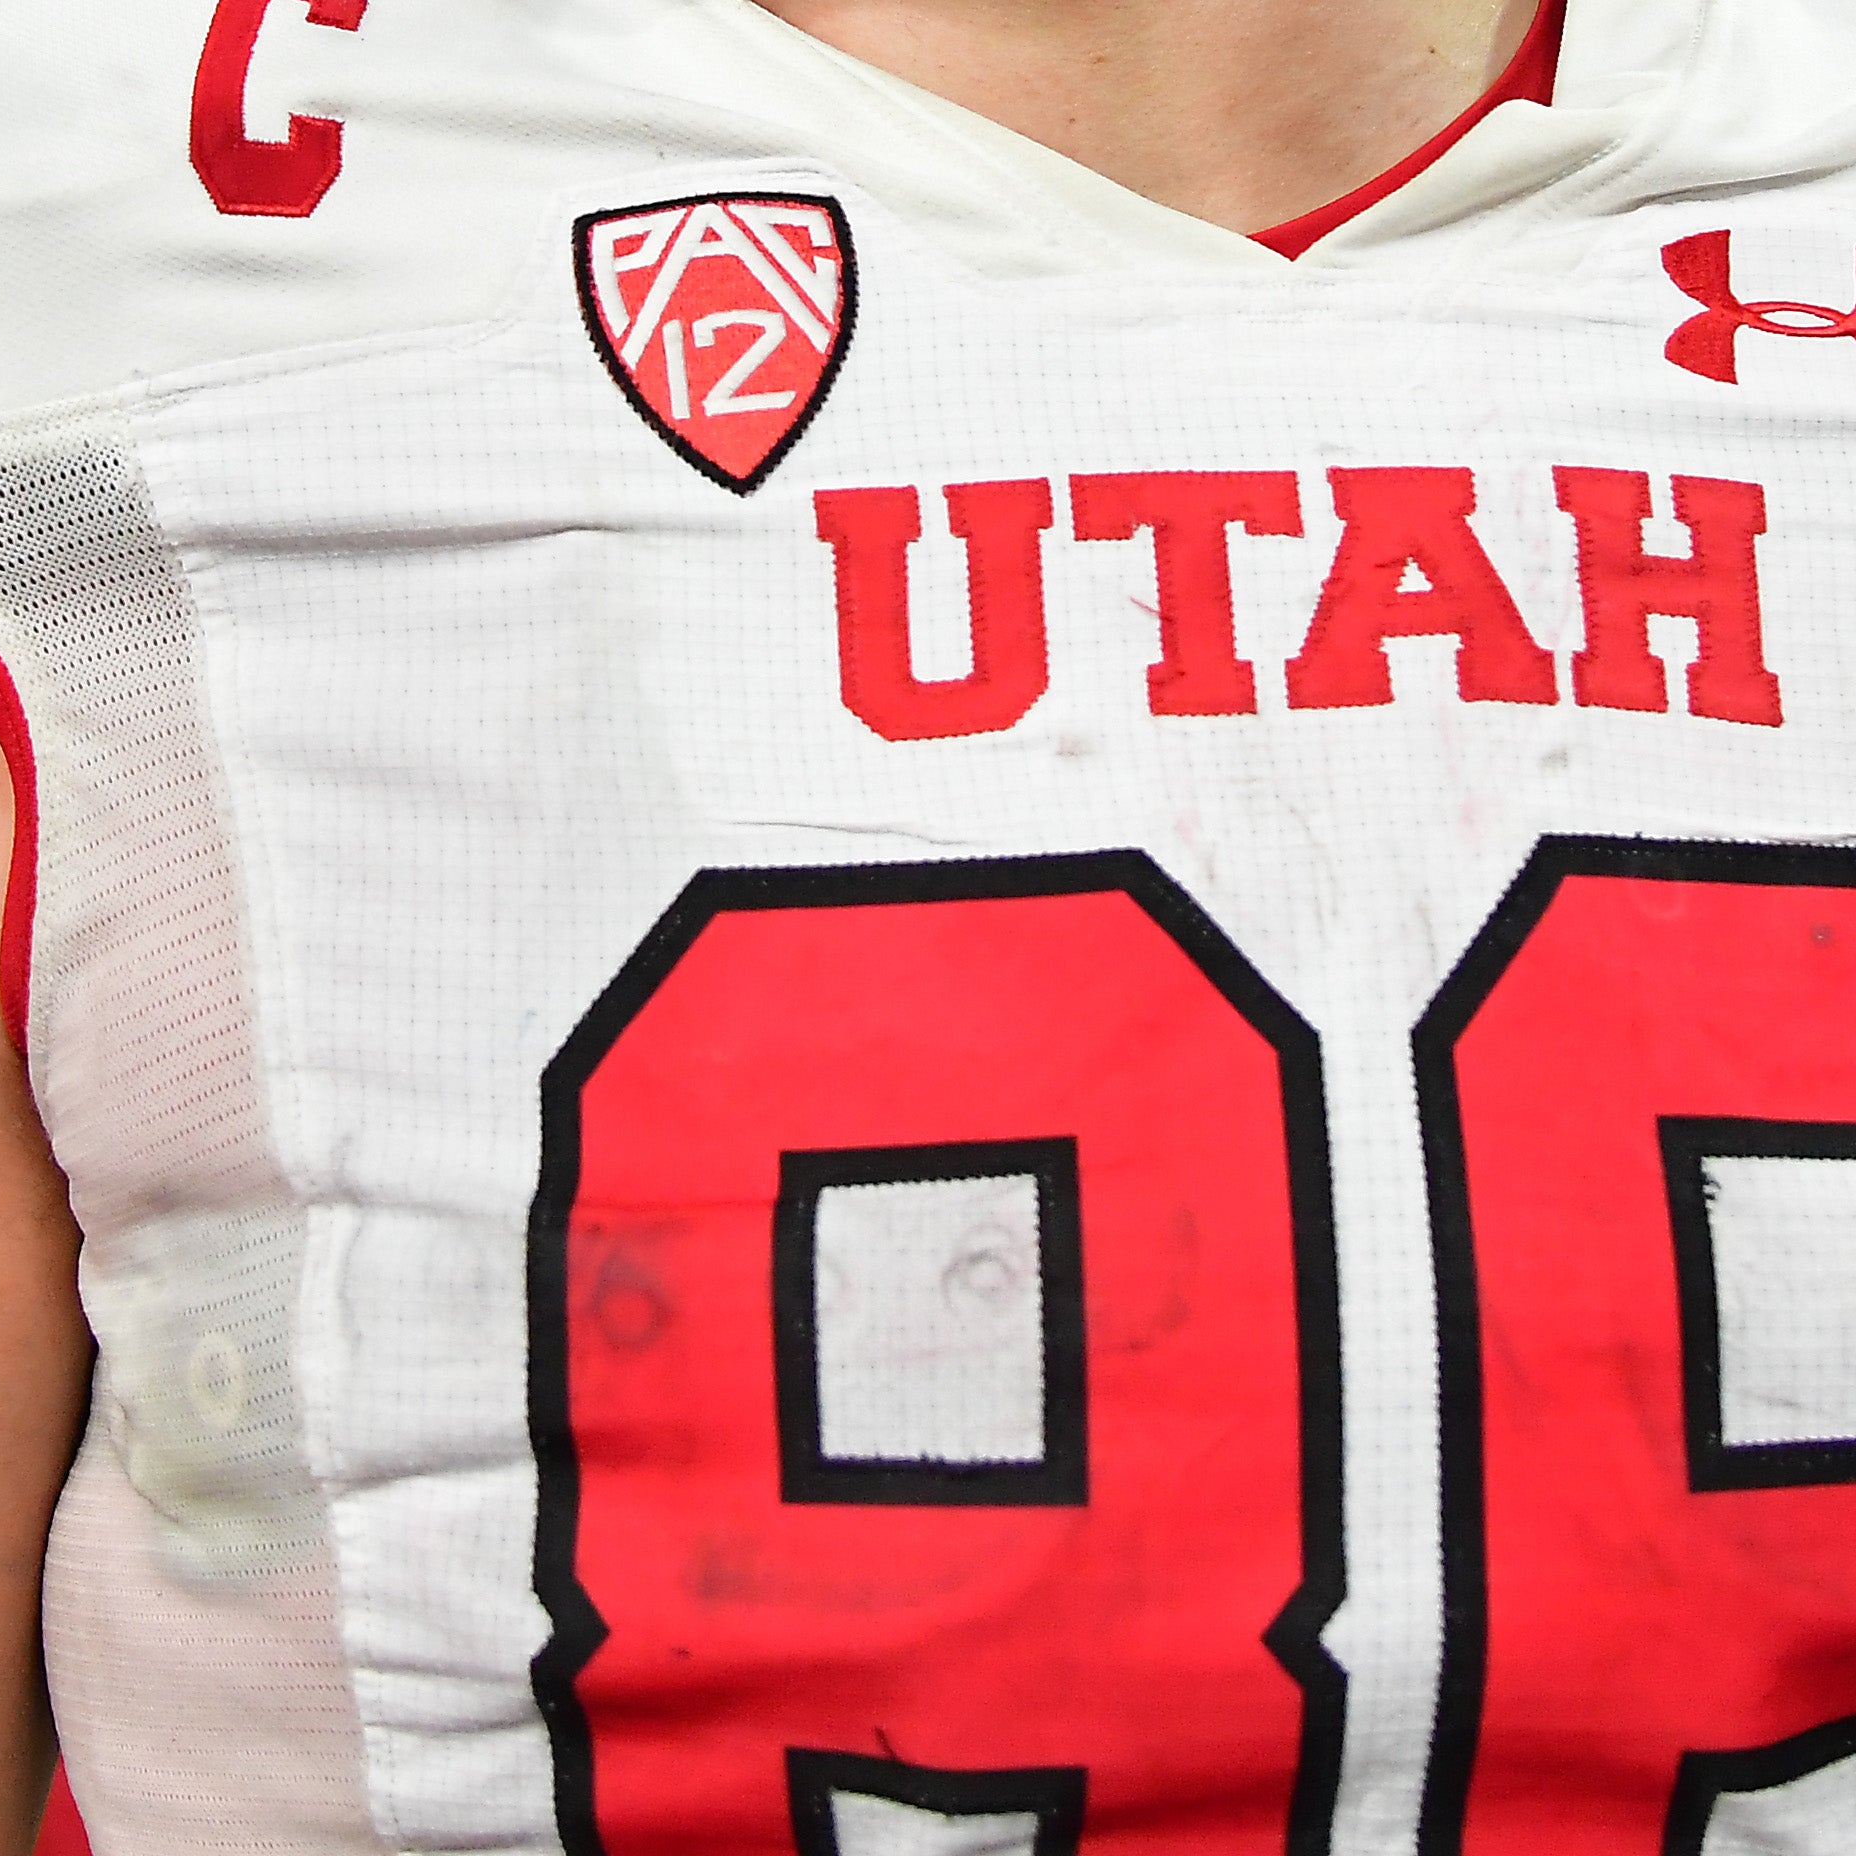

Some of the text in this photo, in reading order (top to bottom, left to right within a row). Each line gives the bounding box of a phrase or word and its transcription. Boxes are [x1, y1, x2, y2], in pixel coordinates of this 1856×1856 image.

[592, 202, 838, 370] PAC
[662, 309, 796, 420] 12
[813, 465, 1784, 742] UTAH
